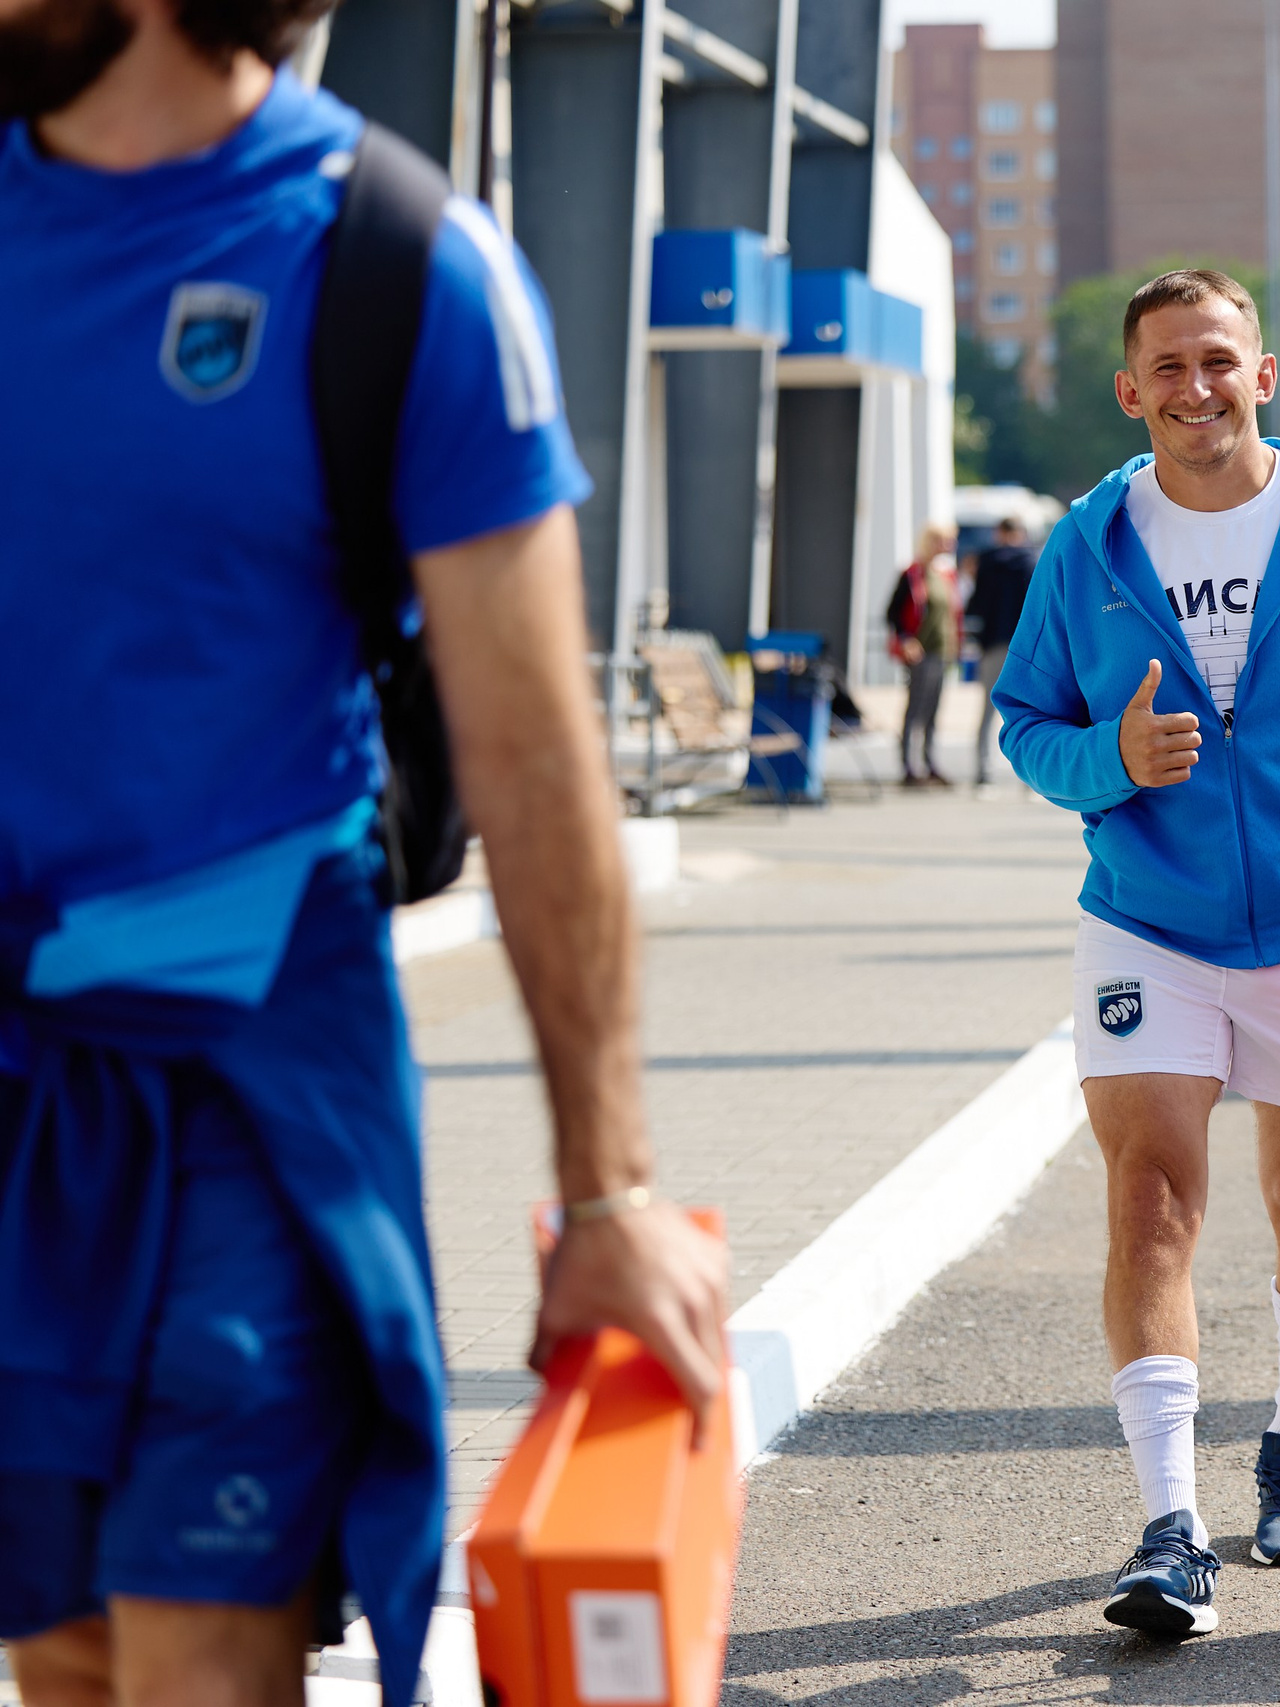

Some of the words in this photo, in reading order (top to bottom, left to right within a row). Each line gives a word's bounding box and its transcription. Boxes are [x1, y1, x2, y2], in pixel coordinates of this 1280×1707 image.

[1165, 578, 1262, 621] ИС
[1097, 981, 1124, 995] ЕНИСЕЙ
[1125, 981, 1141, 990] СТМ
